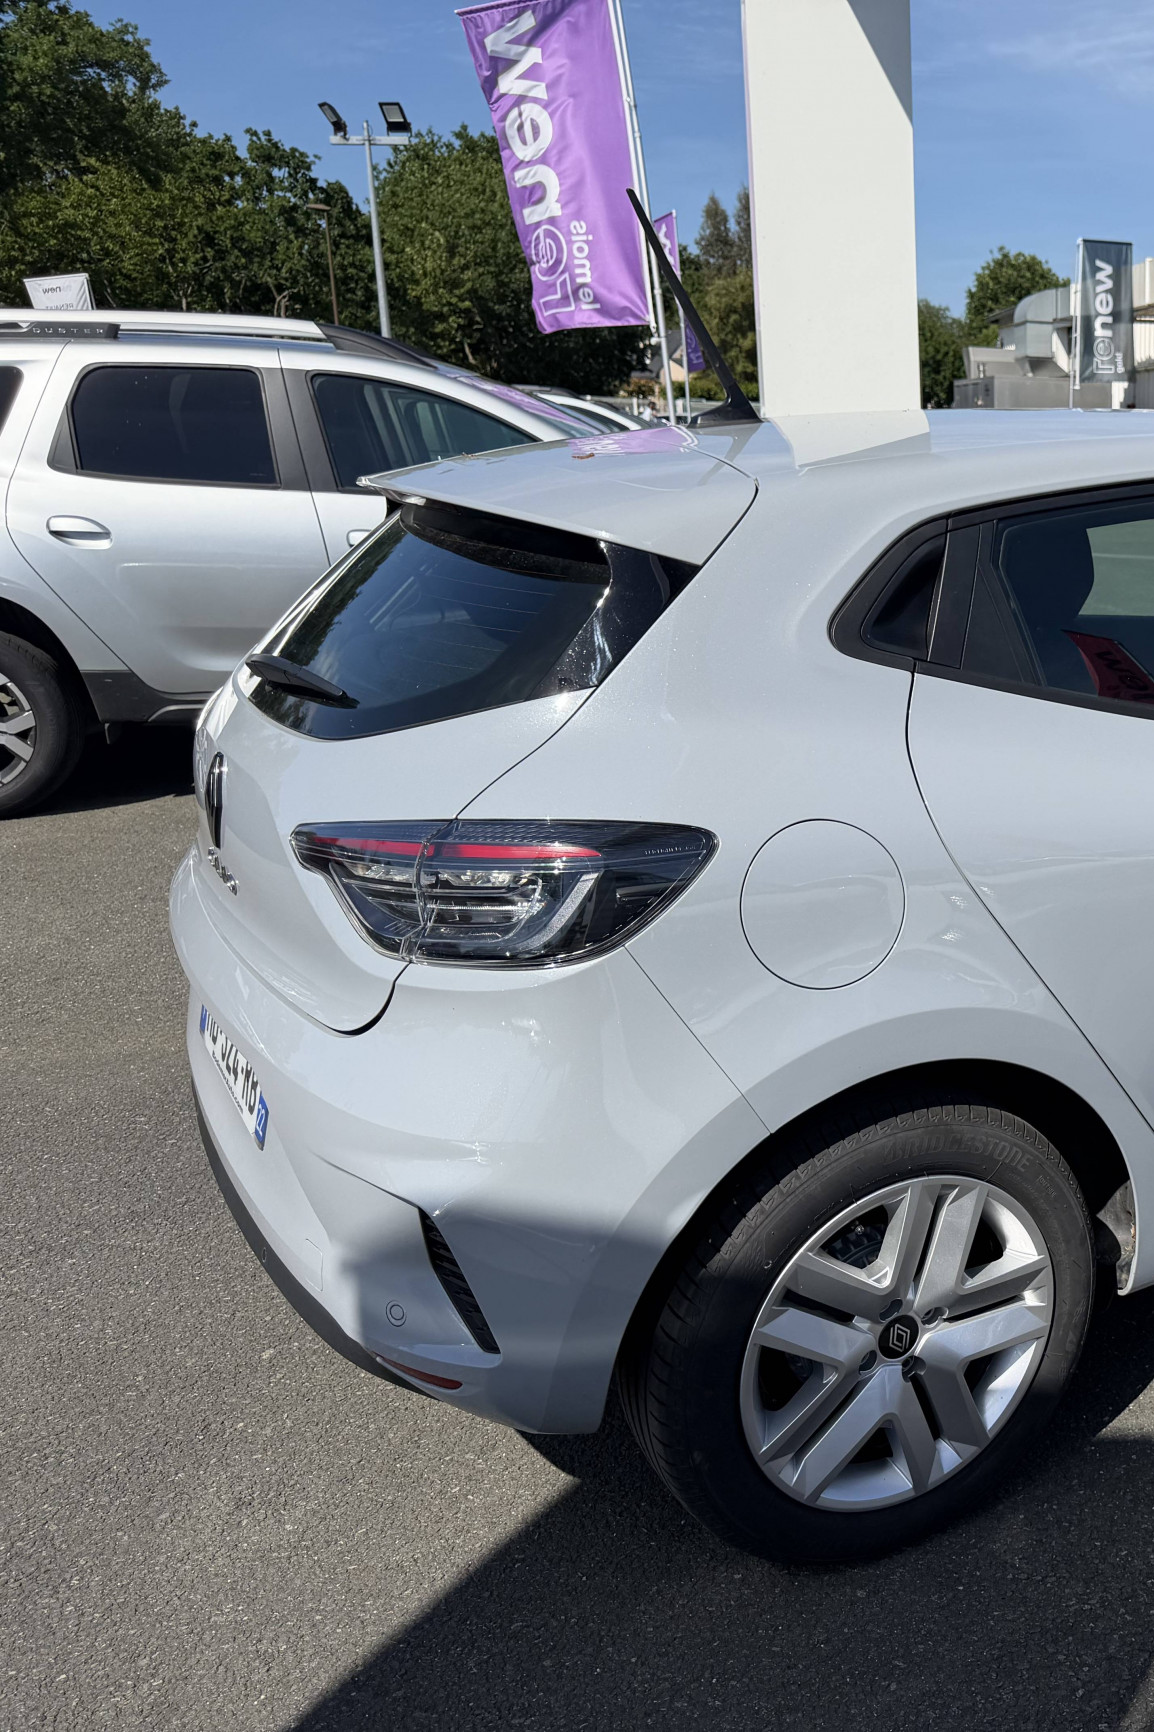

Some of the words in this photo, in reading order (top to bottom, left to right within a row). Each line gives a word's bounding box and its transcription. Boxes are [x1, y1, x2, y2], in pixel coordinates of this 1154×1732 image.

[1092, 258, 1115, 374] renew
[1115, 351, 1126, 374] gold
[883, 1132, 1034, 1174] BRIDGESTONE
